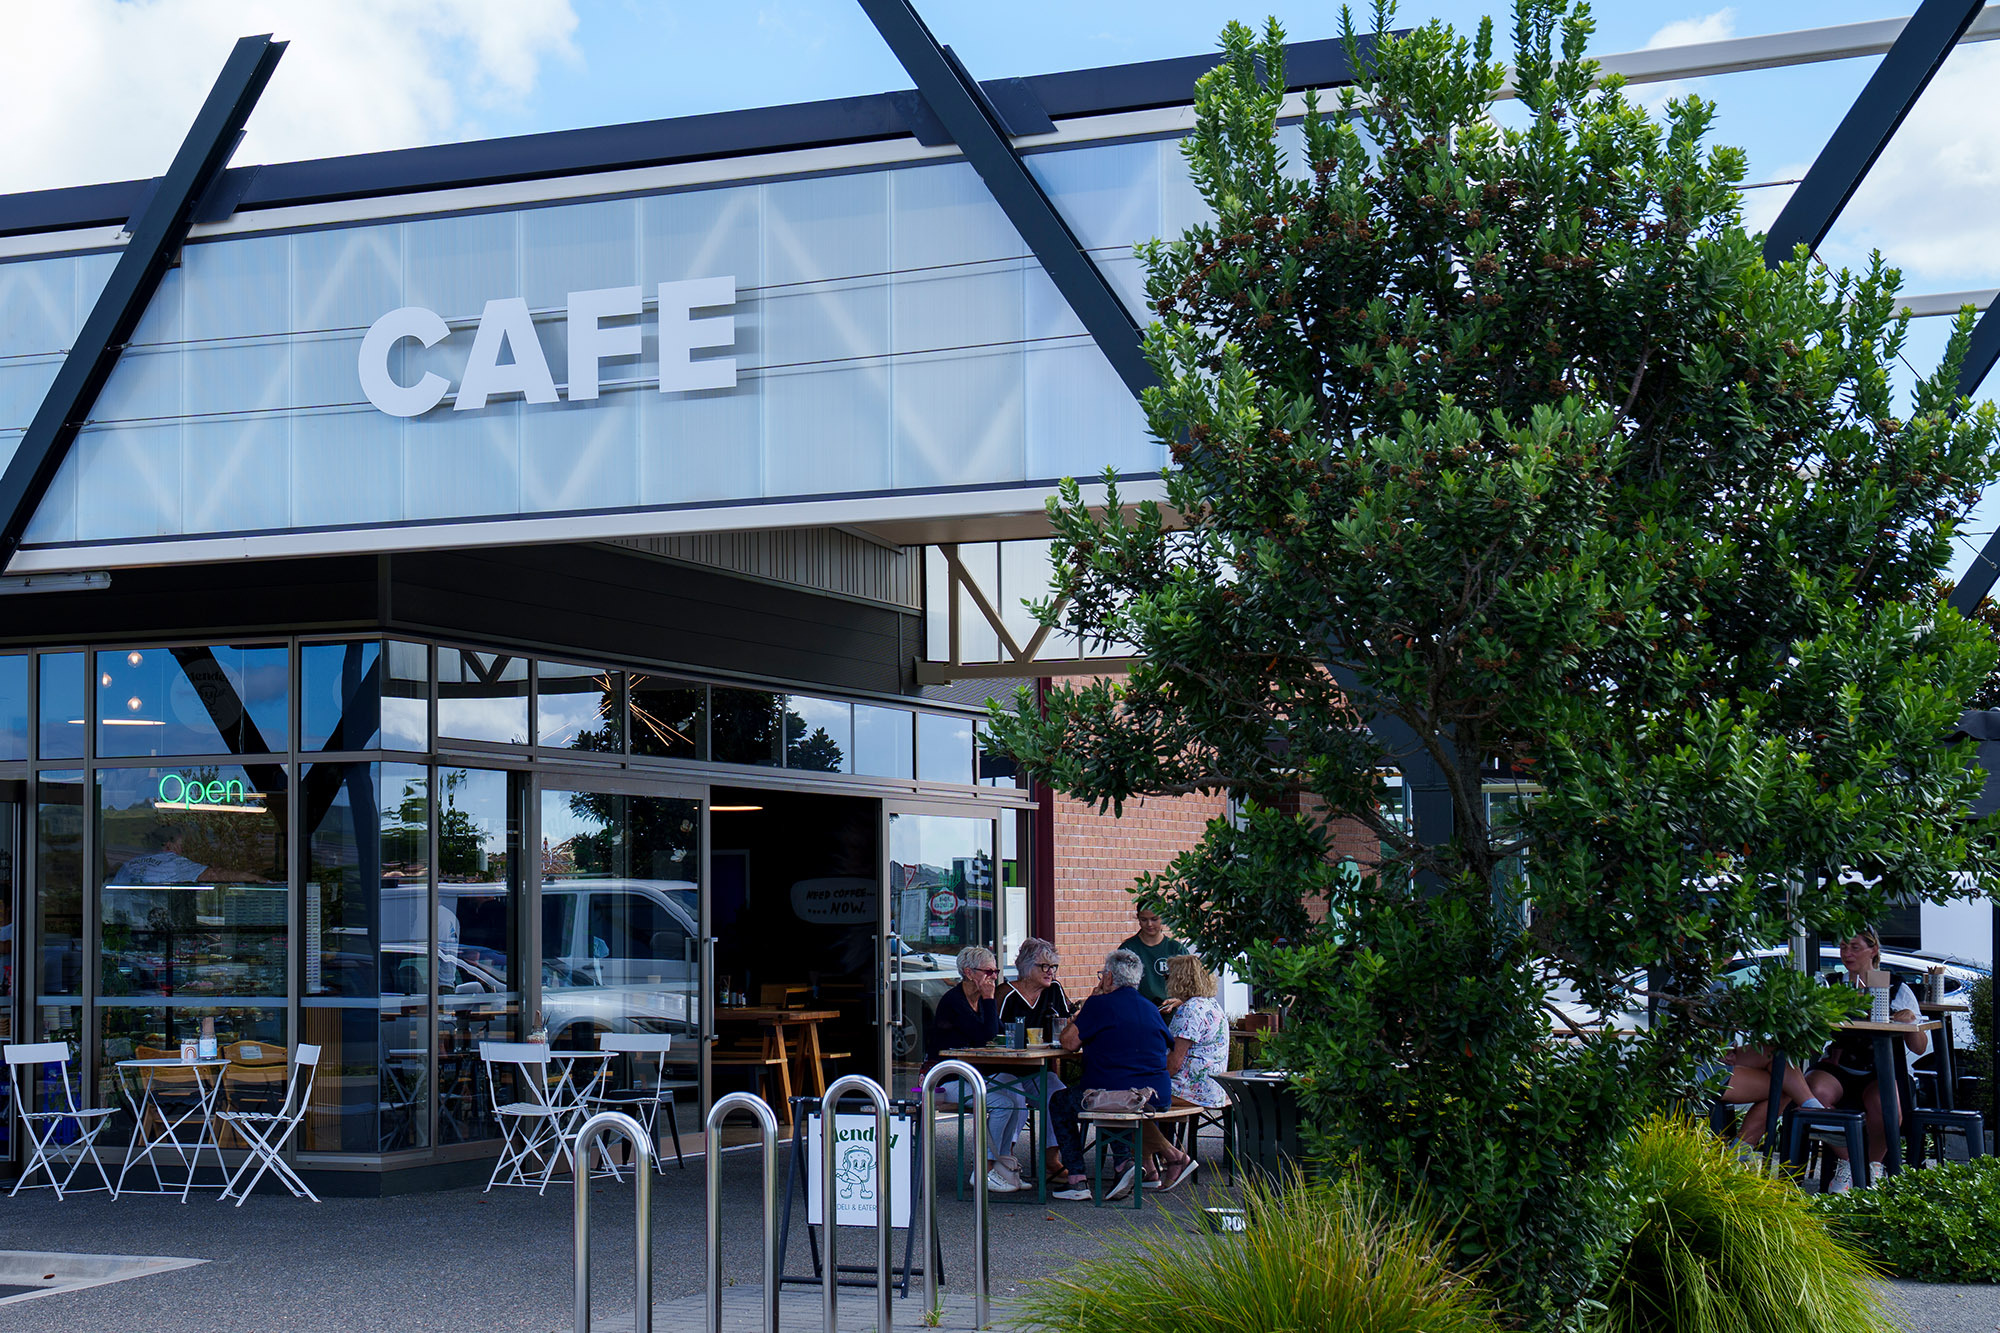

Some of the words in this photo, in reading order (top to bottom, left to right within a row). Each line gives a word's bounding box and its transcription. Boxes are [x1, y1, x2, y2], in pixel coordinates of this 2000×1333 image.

[358, 276, 737, 417] CAFE
[159, 774, 244, 810] Open
[807, 890, 831, 900] NEED
[857, 1203, 878, 1212] EATER
